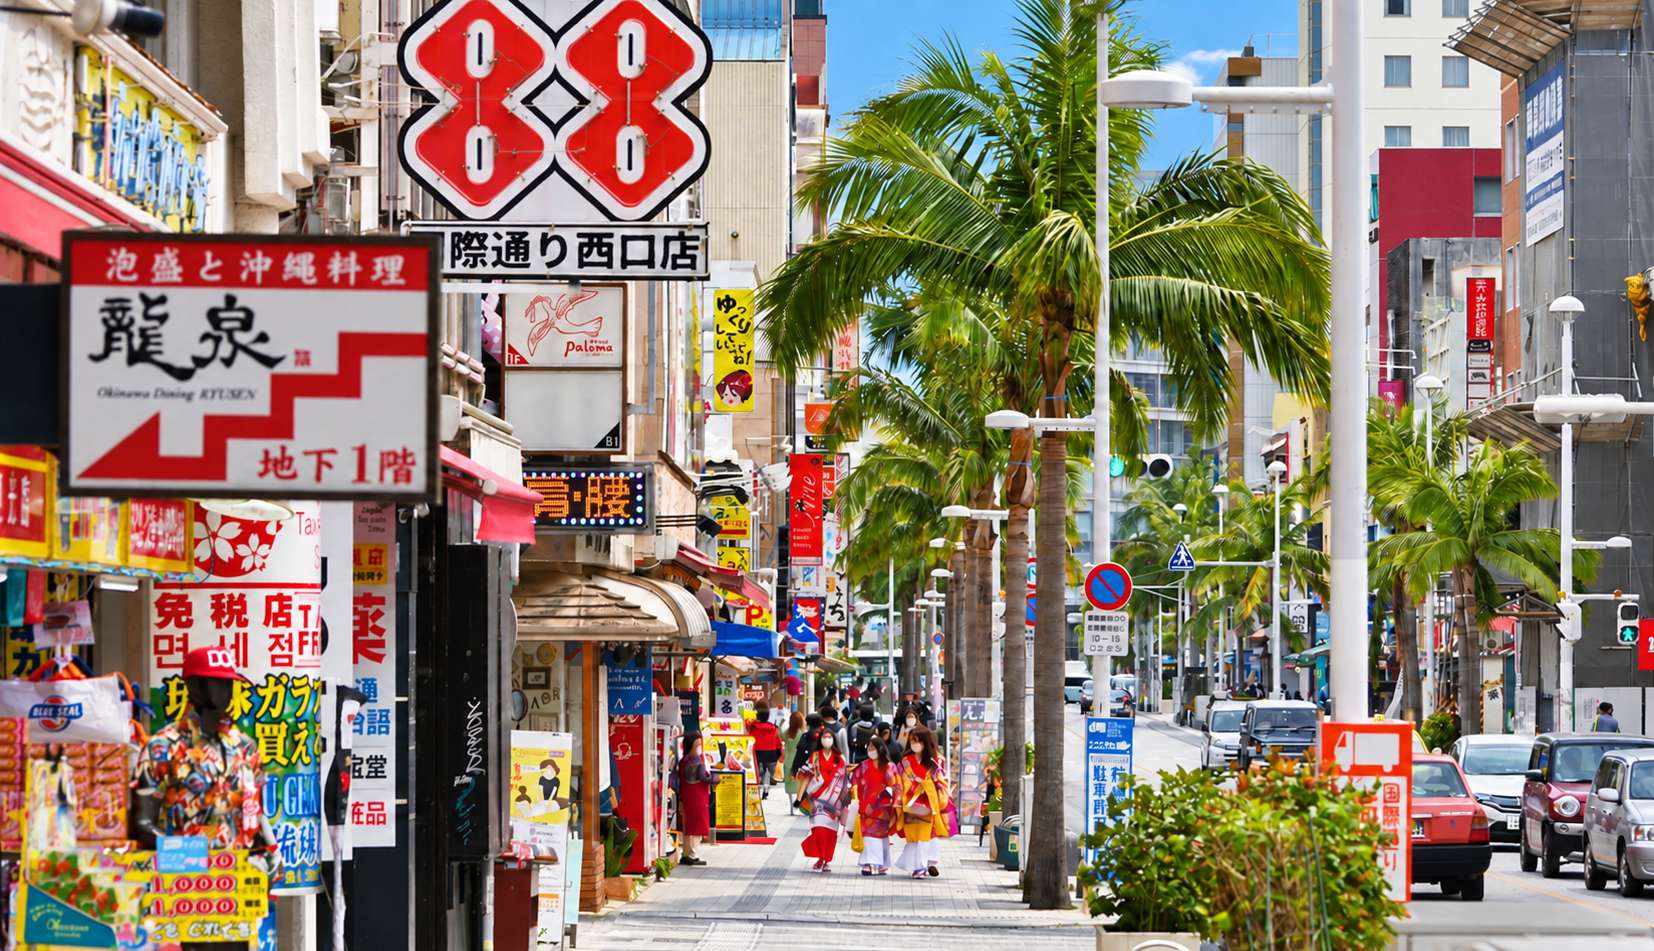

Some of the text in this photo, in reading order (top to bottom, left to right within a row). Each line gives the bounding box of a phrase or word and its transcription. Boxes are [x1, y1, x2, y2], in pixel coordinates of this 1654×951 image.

[443, 231, 701, 270] 際通り西口店
[88, 292, 286, 382] 龍泉
[97, 387, 258, 403] Okinawa Dining RYUSEN
[605, 436, 619, 447] B1
[257, 444, 417, 484] 地下1階
[154, 592, 294, 629] 免税店
[33, 703, 81, 717] BLUE SEAL
[1382, 782, 1400, 871] 国際り
